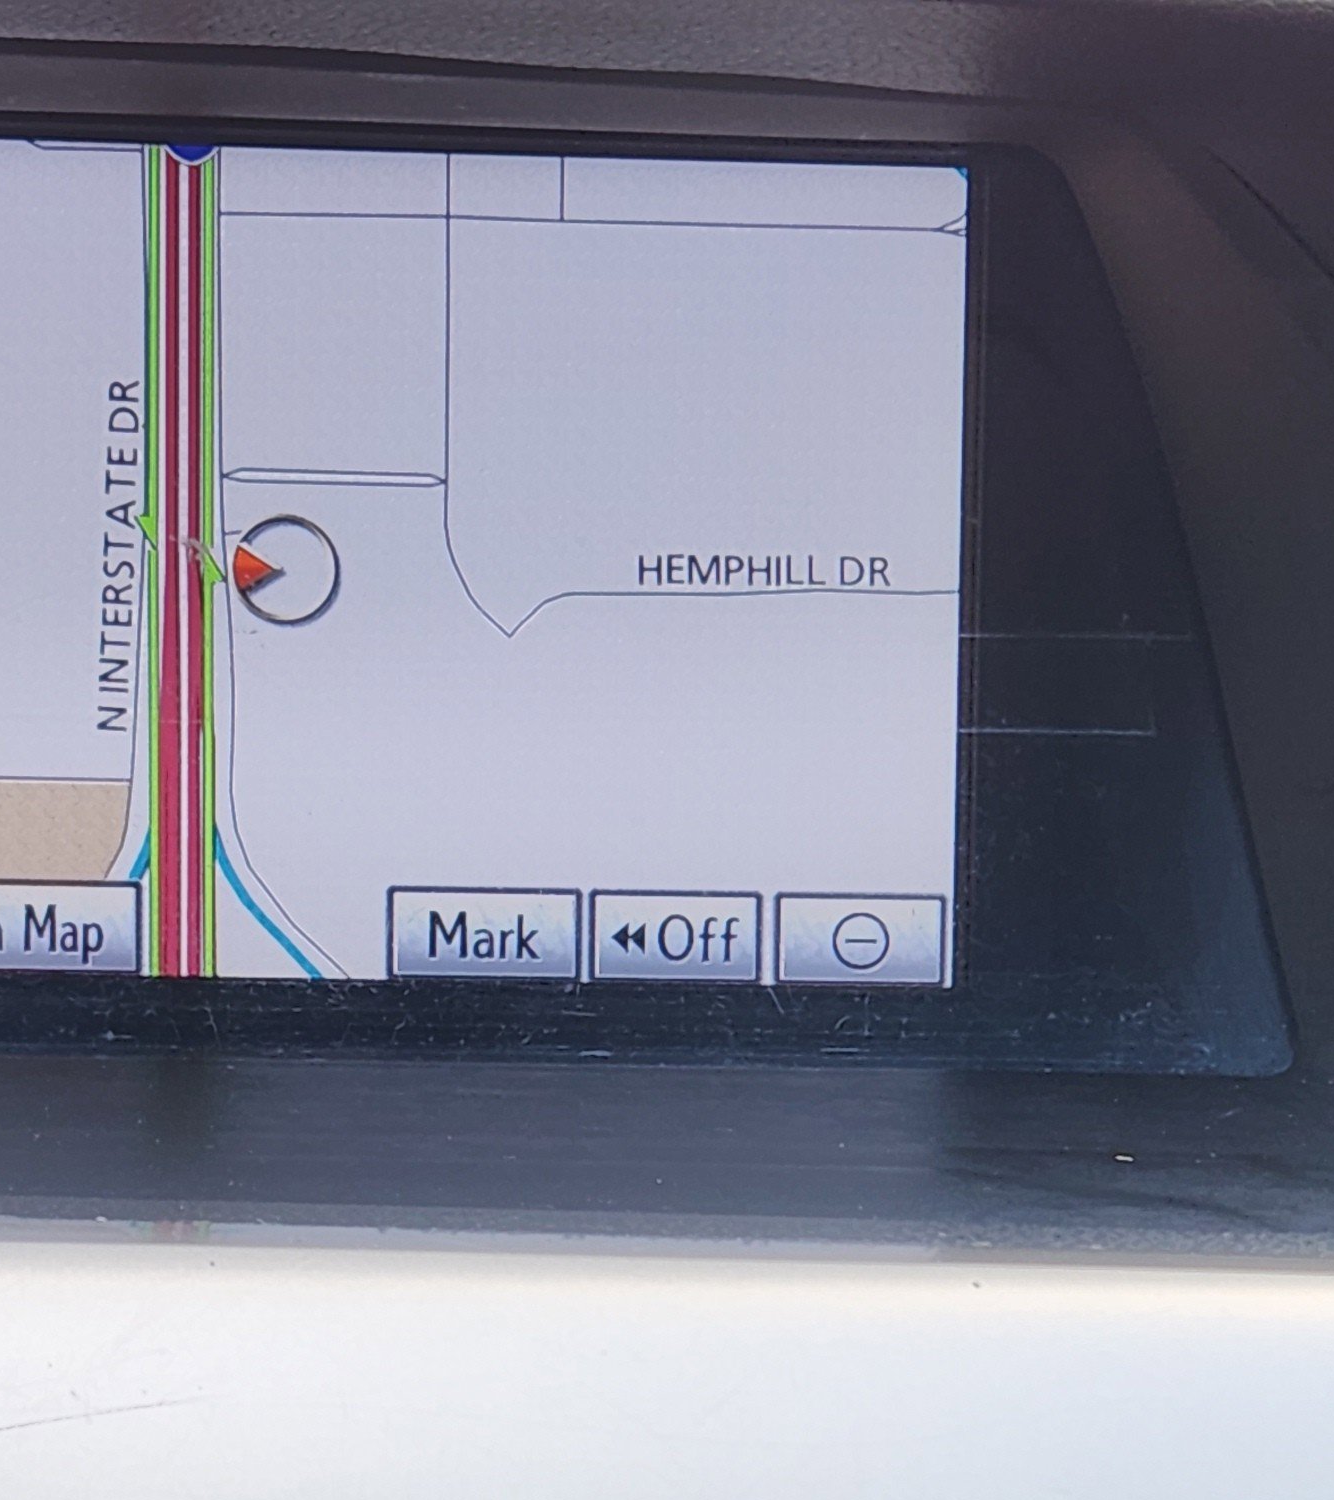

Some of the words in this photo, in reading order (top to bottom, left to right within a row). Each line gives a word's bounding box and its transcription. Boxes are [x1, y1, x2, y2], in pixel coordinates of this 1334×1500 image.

[108, 379, 141, 433] DR
[99, 446, 138, 693] INTERSTATE
[637, 554, 827, 588] HEMPHILL
[839, 555, 891, 588] DR
[97, 705, 128, 732] N
[23, 905, 105, 965] Map
[428, 910, 542, 962] Mark
[657, 913, 741, 964] Off
